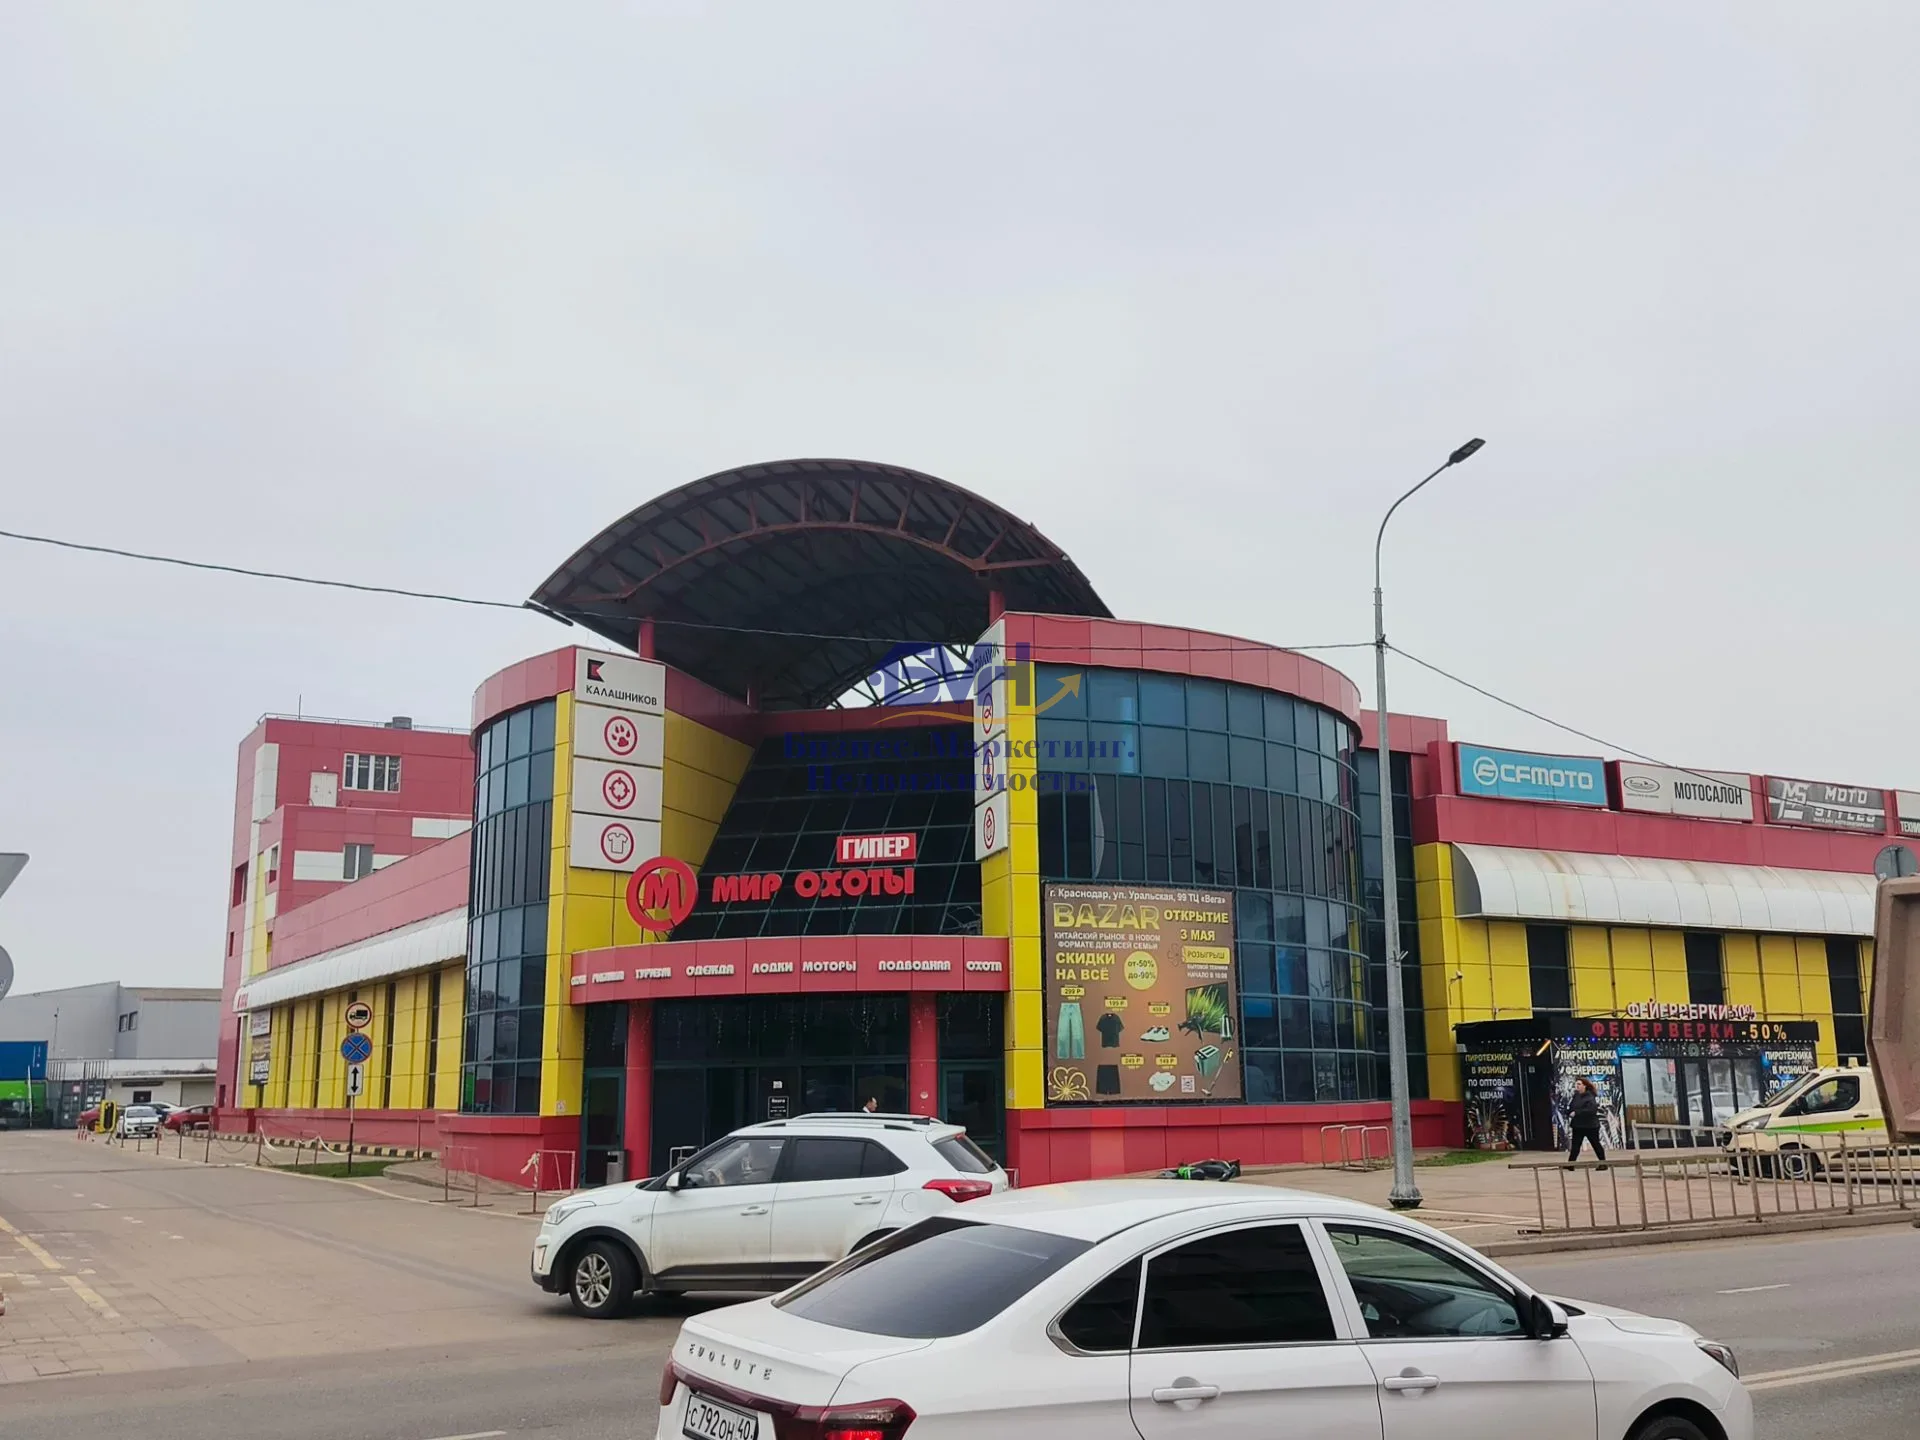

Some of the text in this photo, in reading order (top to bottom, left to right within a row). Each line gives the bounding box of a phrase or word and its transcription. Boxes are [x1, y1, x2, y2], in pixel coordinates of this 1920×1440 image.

[586, 685, 657, 706] КАЛАШНИКОВ
[1500, 764, 1594, 790] CFMOTO
[1674, 782, 1743, 805] МОТОСАЛОН
[1825, 786, 1868, 804] MOTO
[842, 836, 910, 859] ГИПЕР
[712, 868, 915, 902] МИР ОХОТЫ
[1058, 889, 1111, 899] Краснодар,
[1113, 892, 1126, 900] ул.
[1128, 891, 1176, 901] Уральская,
[1188, 893, 1199, 903] ТЦ
[1053, 903, 1160, 930] BAZAR
[1164, 909, 1229, 924] ОТКРЫТИЕ
[1054, 931, 1098, 940] КИТАЙСКИЙ
[1136, 934, 1161, 942] НОВОМ
[1180, 929, 1216, 941] 3 МАЯ
[1058, 941, 1095, 949] ФОРМАТЕ
[1096, 942, 1111, 950] ДЛЯ
[1055, 952, 1116, 966] СКИДКИ
[1187, 951, 1225, 960] РОЗЫГРЫШ
[686, 964, 735, 976] ОДЕЖДА
[752, 961, 793, 974] ЛОДКИ
[803, 961, 857, 972] МОТОРЫ
[878, 960, 951, 971] ПОДВОДНАЯ
[1055, 967, 1110, 981] НА ВСЁ
[1741, 1024, 1787, 1040] -50%
[1465, 1053, 1513, 1063] ПИРОТЕХНИКА
[1561, 1050, 1618, 1060] ПИРОТЕХНИКА
[1765, 1051, 1813, 1061] ПИРОТЕХНИКА
[1472, 1066, 1508, 1075] В РОЗНИЦУ
[1565, 1064, 1616, 1075] ФЕЙЕРВЕРКИ
[1772, 1066, 1777, 1074] В
[1468, 1078, 1513, 1087] ПО ОПТОВЫМ
[1770, 1080, 1779, 1089] ПО
[1480, 1092, 1503, 1100] ЦЕНАМ
